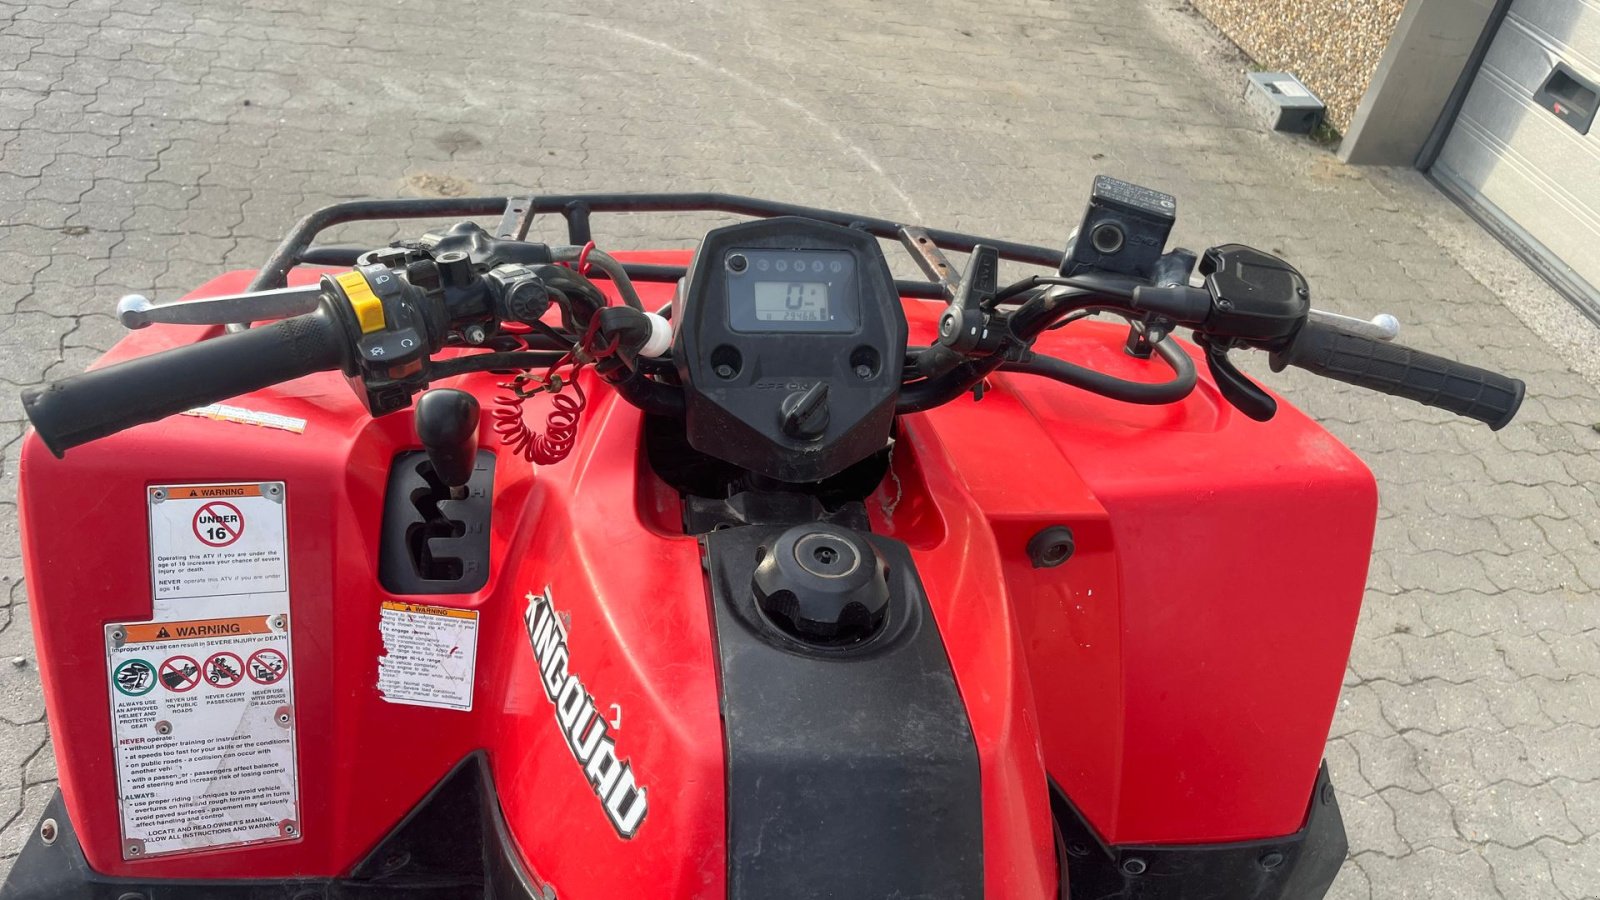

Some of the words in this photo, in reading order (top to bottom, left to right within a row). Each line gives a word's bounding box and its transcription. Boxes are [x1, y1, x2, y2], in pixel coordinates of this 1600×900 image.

[201, 488, 244, 497] WARNING
[199, 515, 238, 524] UNDER
[207, 528, 226, 540] 16
[416, 607, 448, 616] WARNING
[176, 623, 241, 637] WARNING
[112, 645, 140, 653] Improper
[126, 704, 158, 712] APPROVED
[120, 716, 156, 724] PROTECTIVE
[180, 738, 205, 747] training
[216, 734, 251, 742] instruction
[138, 751, 162, 760] speeds
[256, 738, 289, 747] conditions
[141, 759, 161, 768] public
[194, 753, 222, 761] collision
[131, 767, 157, 775] another
[153, 772, 188, 782] passener
[194, 768, 232, 777] passengers
[254, 761, 279, 769] balance
[146, 780, 174, 789] steering
[190, 775, 217, 783] increase
[241, 770, 261, 779] losing
[263, 767, 285, 775] control
[172, 795, 191, 804] riding
[257, 784, 280, 792] vehicle
[135, 804, 167, 814] overturns
[208, 797, 228, 806] rough
[229, 794, 250, 802] terrain
[135, 813, 153, 821] avoid
[156, 811, 176, 820] paved
[177, 807, 205, 816] surfaces
[211, 803, 243, 813] pavement
[260, 797, 289, 807] seriously
[136, 820, 155, 828] affect
[156, 816, 185, 827] handling
[201, 811, 224, 820] control
[143, 835, 166, 843] OLLOW
[183, 827, 231, 838] INSTRUCTIONS
[148, 828, 175, 836] LOCATE
[177, 825, 192, 833] AND
